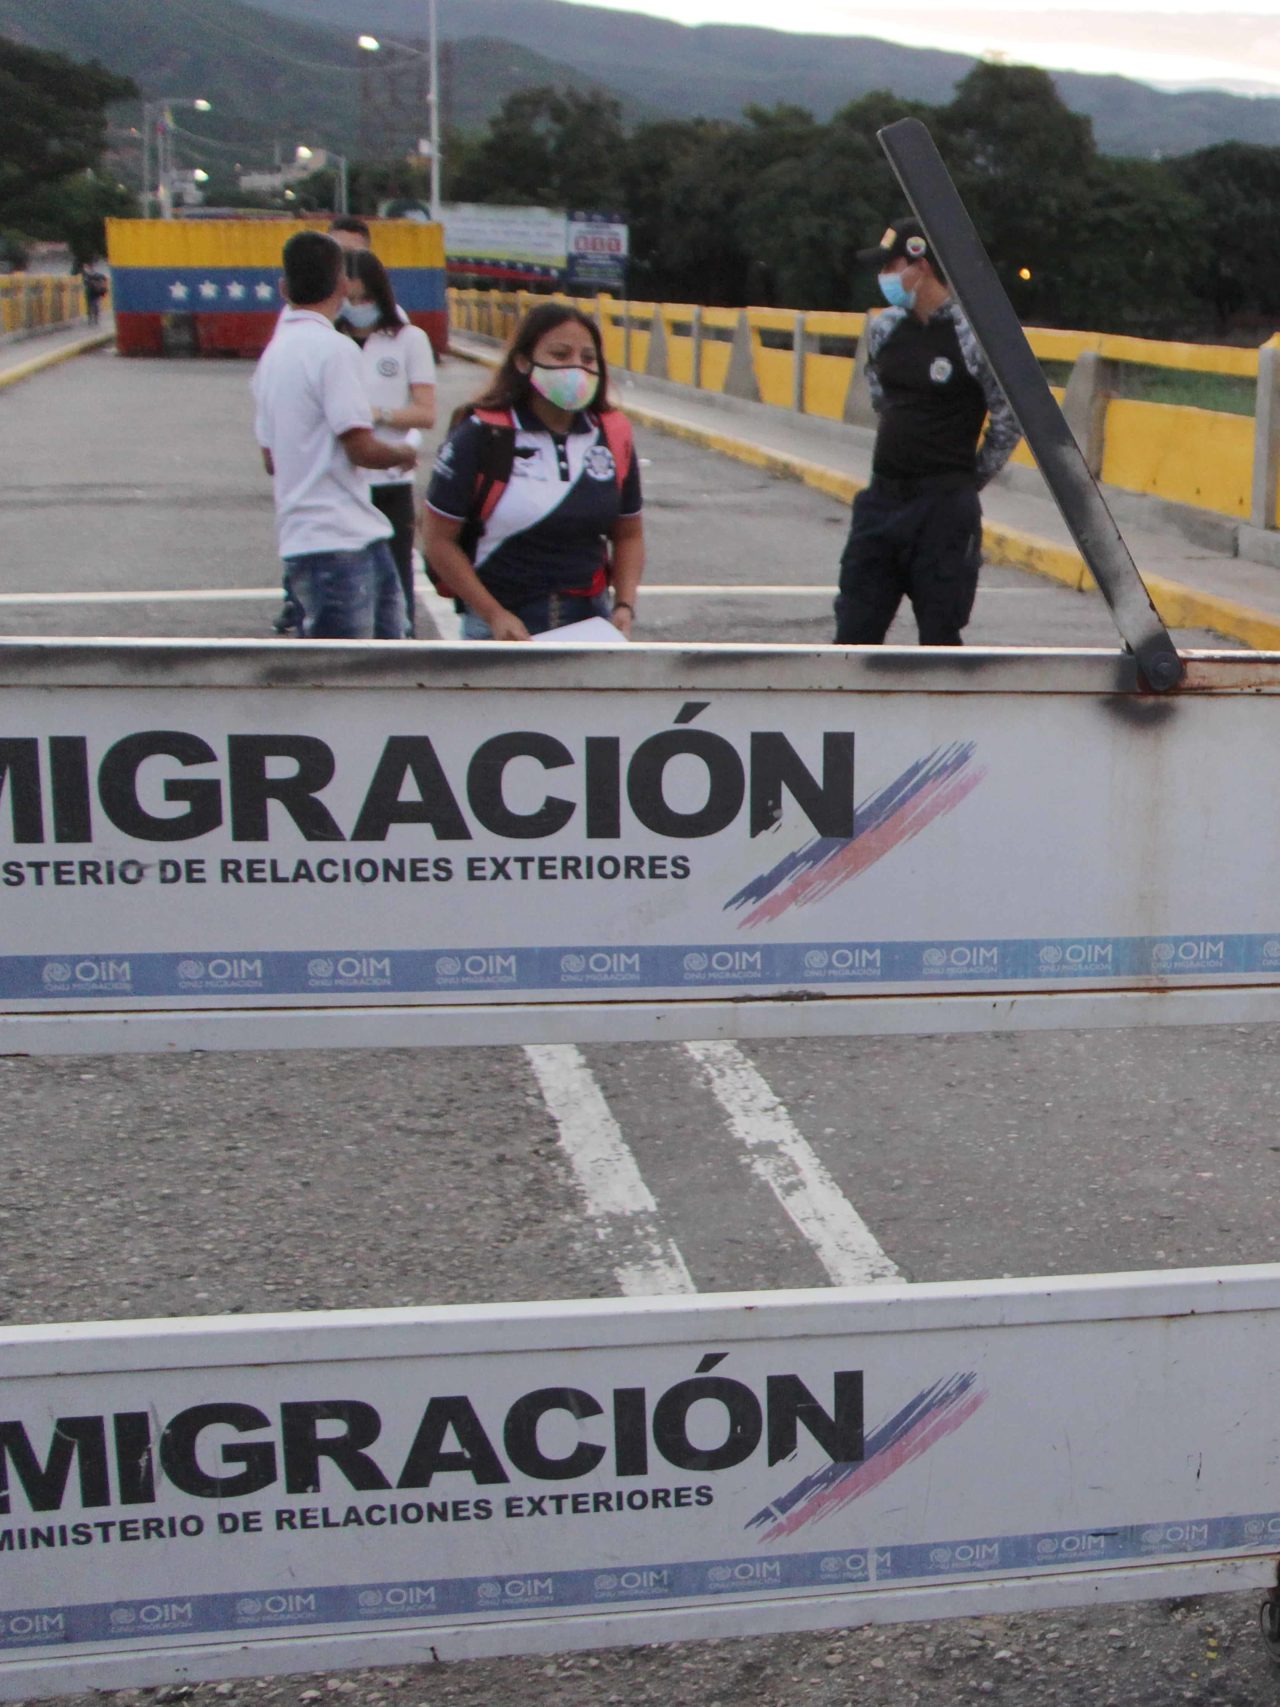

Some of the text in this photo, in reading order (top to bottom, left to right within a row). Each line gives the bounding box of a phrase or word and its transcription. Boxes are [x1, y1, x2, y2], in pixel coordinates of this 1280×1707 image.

[159, 858, 207, 884] DE
[220, 856, 455, 884] RELACIONES
[466, 855, 692, 881] EXTERIORES
[711, 950, 761, 970] OIM
[831, 948, 881, 968] OIM
[950, 946, 998, 966] OIM
[1065, 943, 1113, 963] OIM
[1178, 940, 1224, 960] OIM
[75, 960, 131, 982] OIM
[208, 959, 262, 979] OIM
[337, 957, 390, 977] OIM
[464, 955, 516, 975] OIM
[588, 952, 640, 973] OIM
[0, 1352, 864, 1514] MIGRACIÓN
[217, 1510, 263, 1534] DE
[275, 1499, 494, 1532] RELACIONES
[505, 1485, 715, 1518] EXTERIORES
[1166, 1523, 1208, 1542] OIM
[846, 1552, 891, 1571] OM
[955, 1543, 999, 1561] OIM
[620, 1569, 668, 1589] OIM
[734, 1561, 780, 1580] OIM
[385, 1586, 436, 1605] OIM
[505, 1577, 553, 1597] OIM
[140, 1602, 192, 1623] OIM
[265, 1593, 316, 1613] OIM
[10, 1613, 65, 1634] OIM
